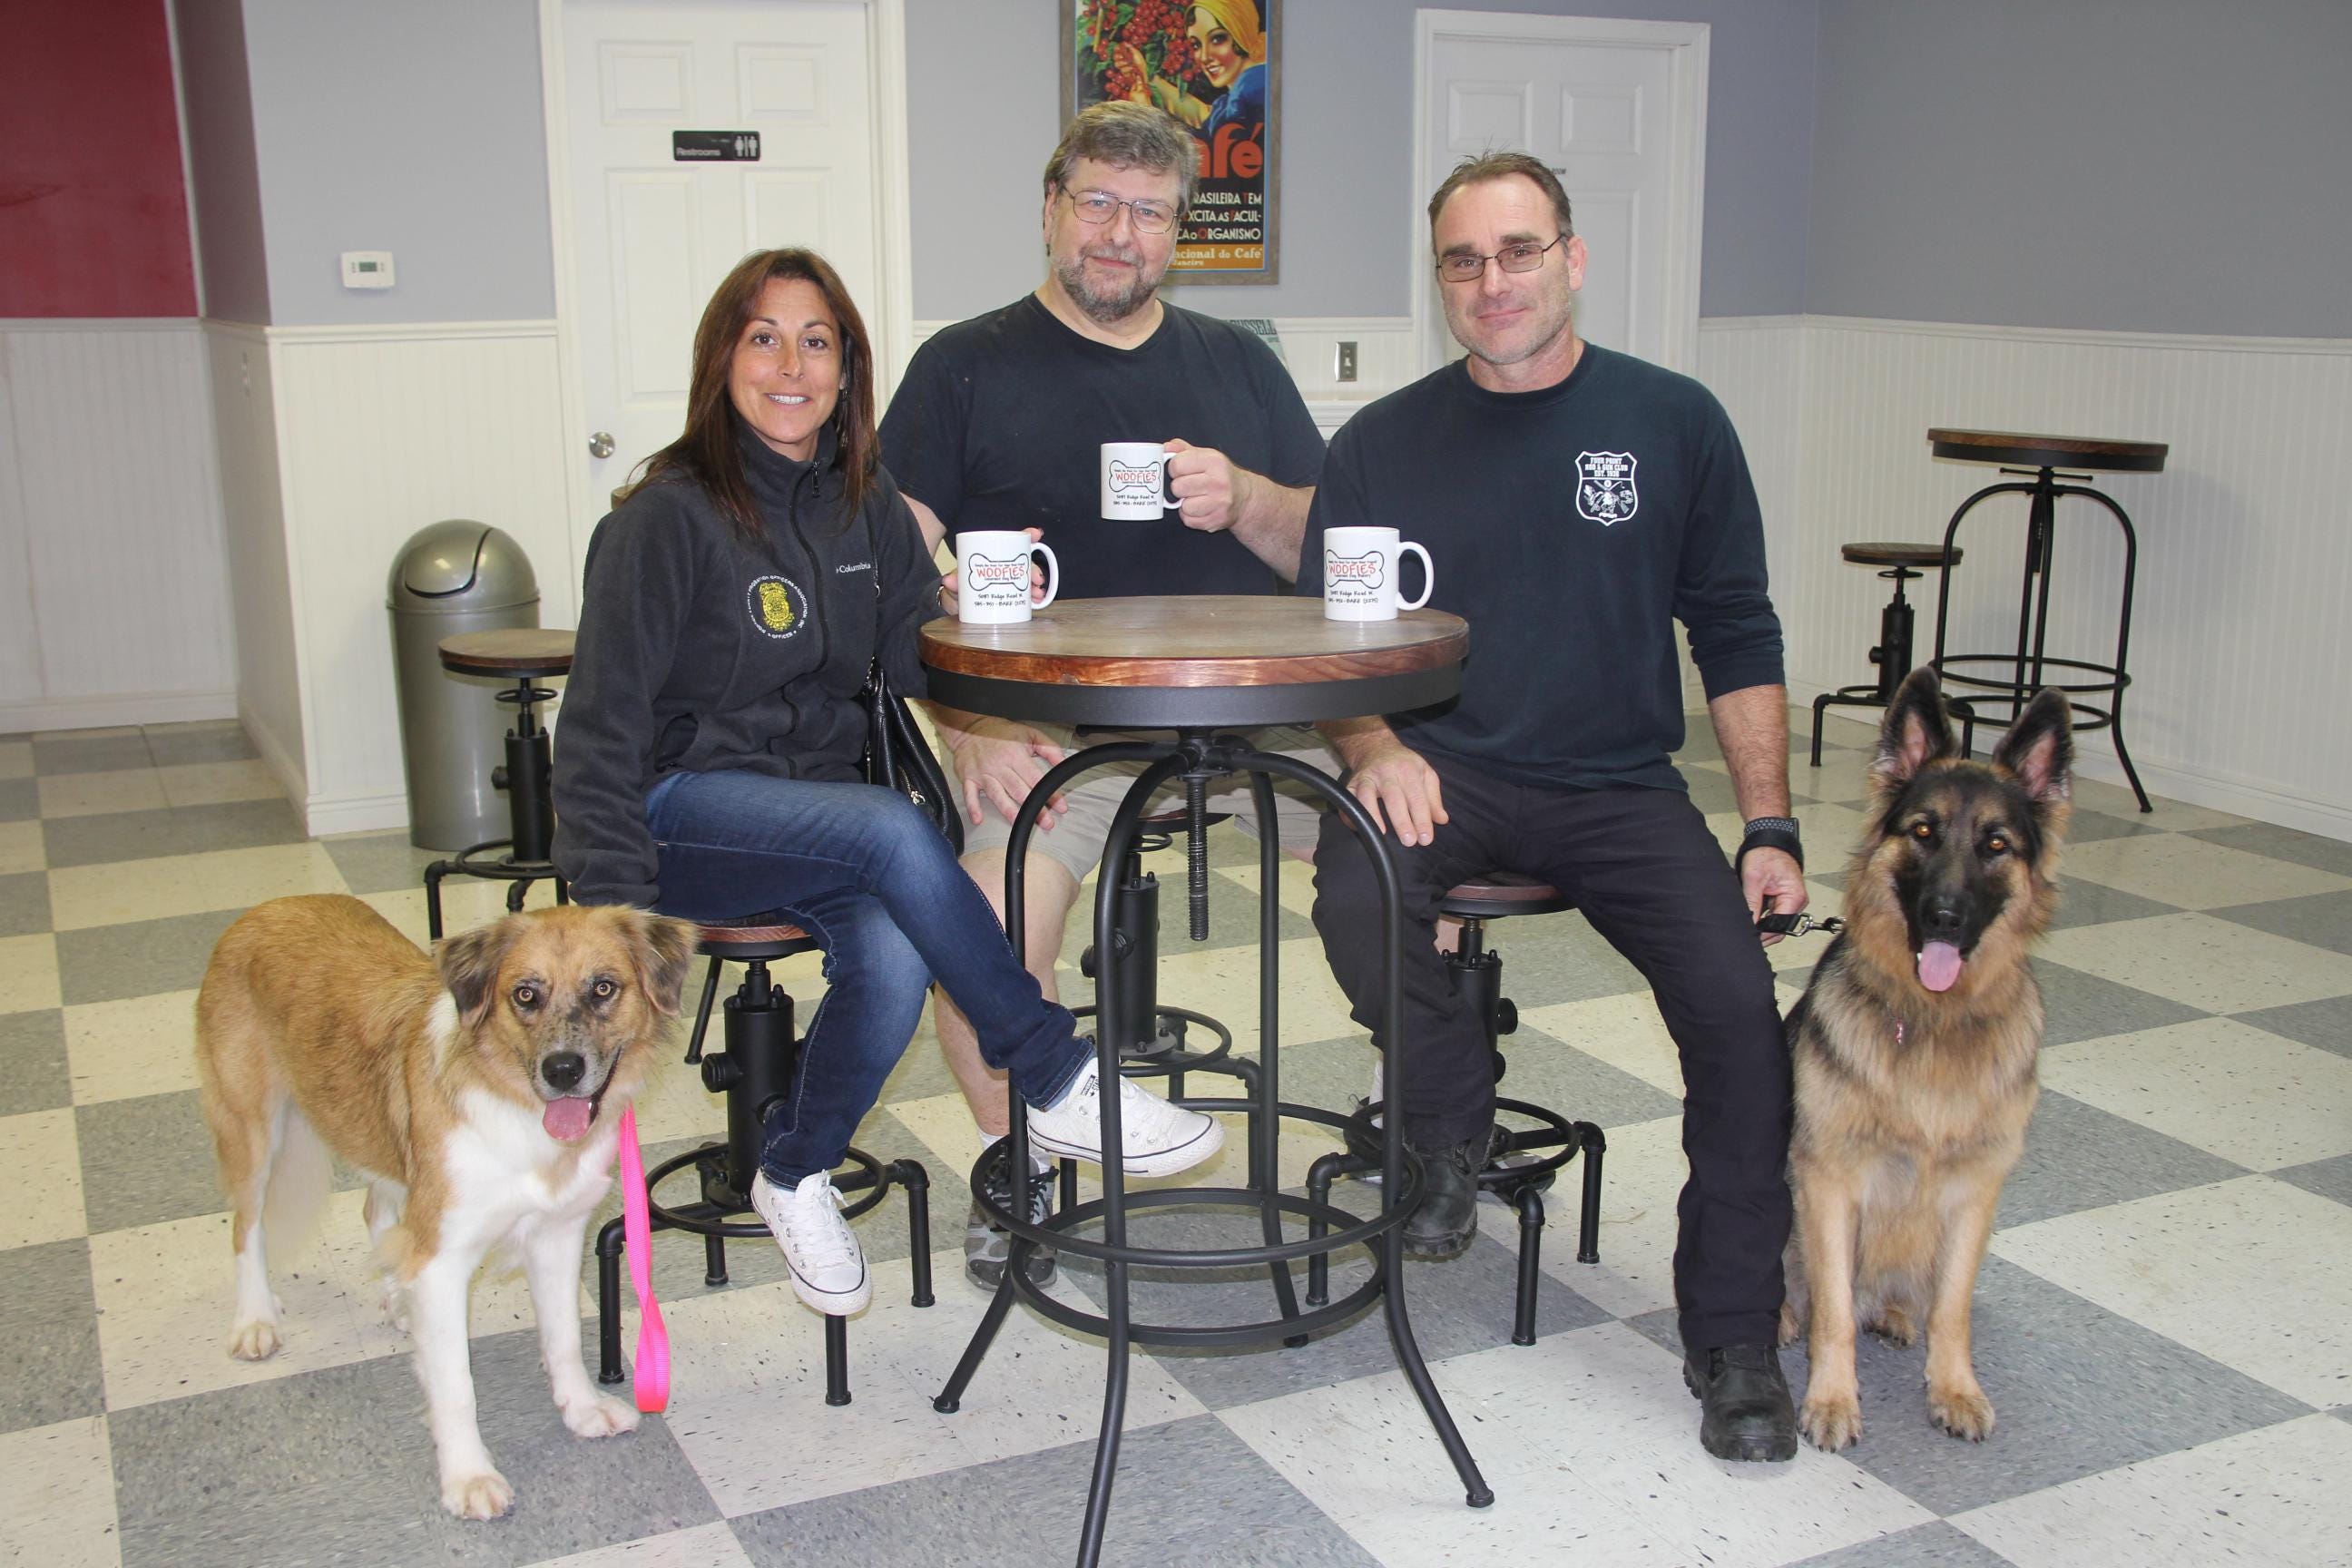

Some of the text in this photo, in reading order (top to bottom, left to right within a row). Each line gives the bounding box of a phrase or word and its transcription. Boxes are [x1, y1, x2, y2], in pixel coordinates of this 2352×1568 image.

[676, 147, 721, 156] Restrooms
[1193, 192, 1262, 204] RASILEIRA TEM
[1198, 228, 1261, 240] ORGANISMO
[1116, 472, 1156, 482] WOOFIES
[839, 563, 871, 573] Columbia
[976, 566, 1024, 578] WOOFIES
[1329, 564, 1376, 574] WOOFIES
